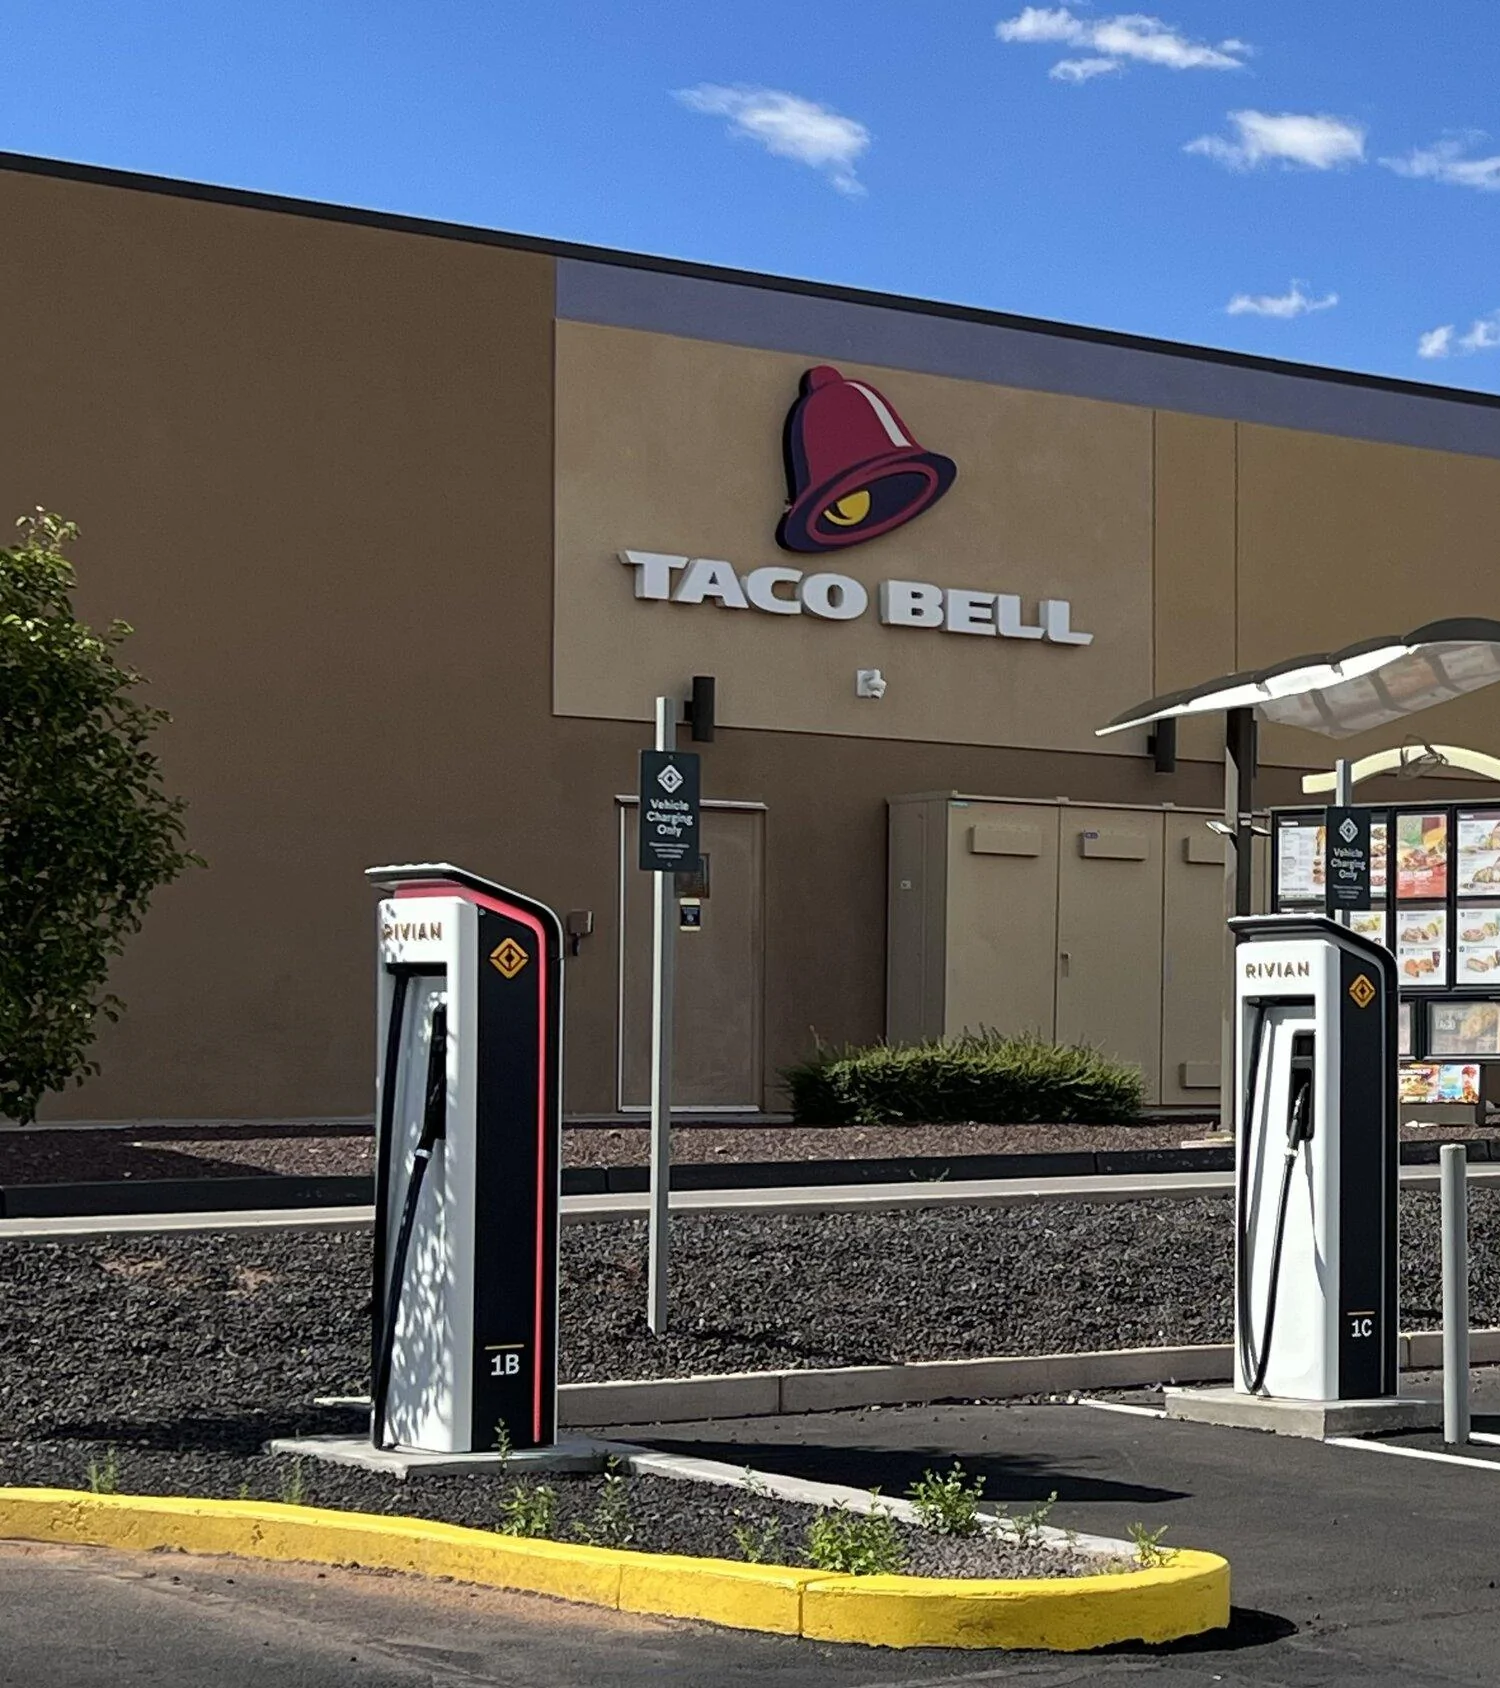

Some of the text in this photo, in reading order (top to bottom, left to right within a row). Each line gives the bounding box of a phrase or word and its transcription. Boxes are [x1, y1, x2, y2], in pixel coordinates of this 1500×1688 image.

[618, 549, 1093, 646] TACO BELL
[650, 799, 689, 811] Vehicle
[646, 811, 693, 826] Charging
[657, 824, 682, 837] Only
[383, 922, 442, 941] RIVIAN
[1245, 961, 1309, 979] RIVIAN
[1351, 1318, 1373, 1338] 1C
[490, 1353, 520, 1376] 1B
